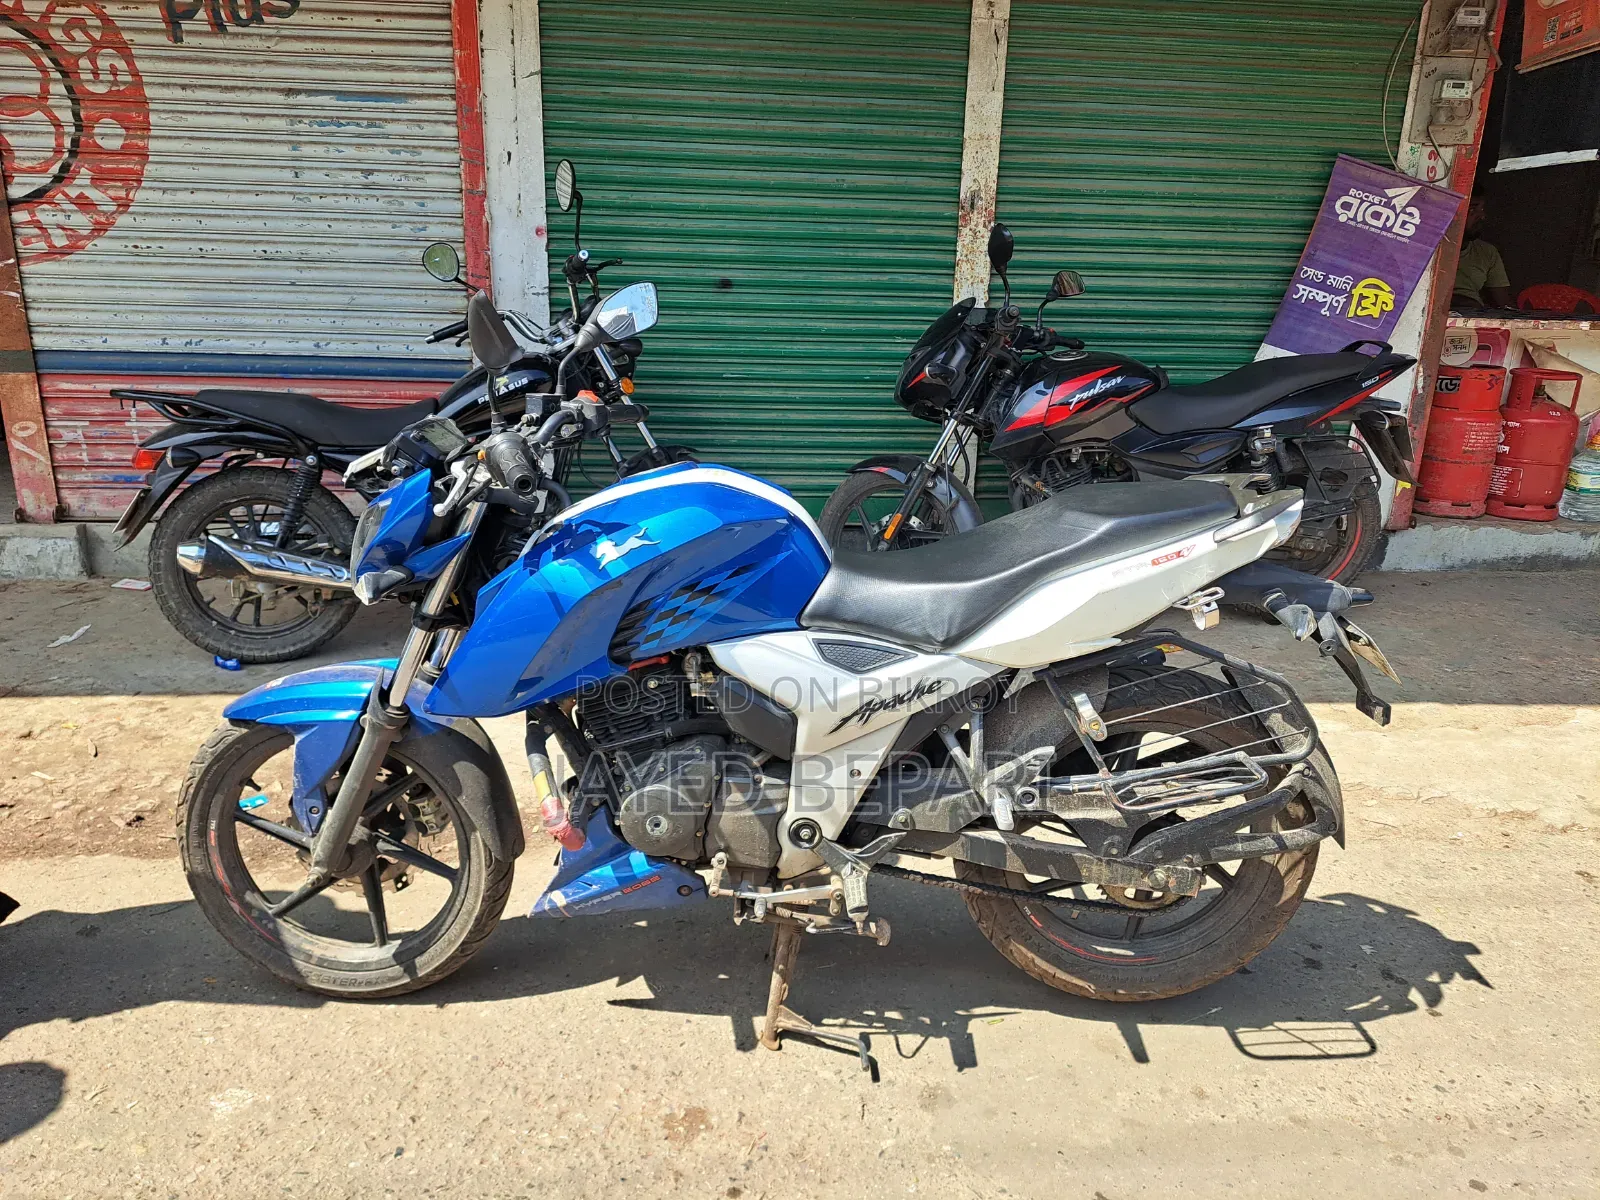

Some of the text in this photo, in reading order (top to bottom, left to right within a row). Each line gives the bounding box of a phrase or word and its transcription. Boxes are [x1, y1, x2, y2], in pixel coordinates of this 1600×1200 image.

[1348, 188, 1388, 206] ROCKET
[1335, 195, 1421, 237] রকেট
[1292, 277, 1395, 318] সম্পূর্ণ ফ্রি
[1326, 275, 1354, 292] মানি
[477, 376, 529, 405] PEASUS
[824, 676, 949, 737] Apache
[573, 891, 622, 910] HYPER
